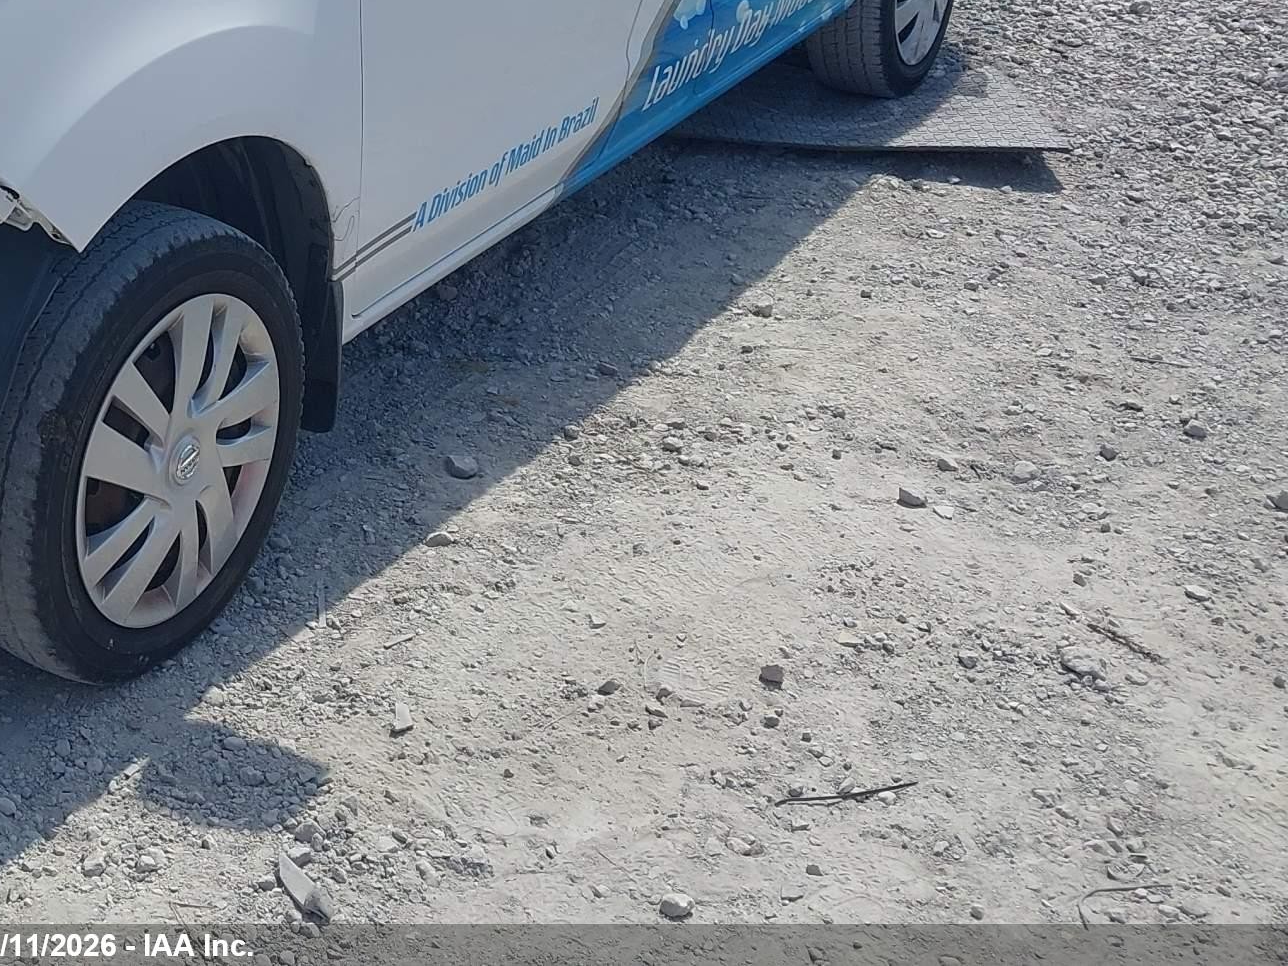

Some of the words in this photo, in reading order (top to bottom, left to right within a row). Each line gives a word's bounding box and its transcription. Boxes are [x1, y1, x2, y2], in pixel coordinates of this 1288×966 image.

[642, 29, 736, 112] Laundry
[730, 3, 775, 54] Day
[413, 201, 428, 232] A
[427, 169, 488, 223] Division
[488, 151, 509, 187] of
[505, 129, 545, 175] Maid
[542, 126, 558, 155] In
[557, 97, 600, 143] Brazil
